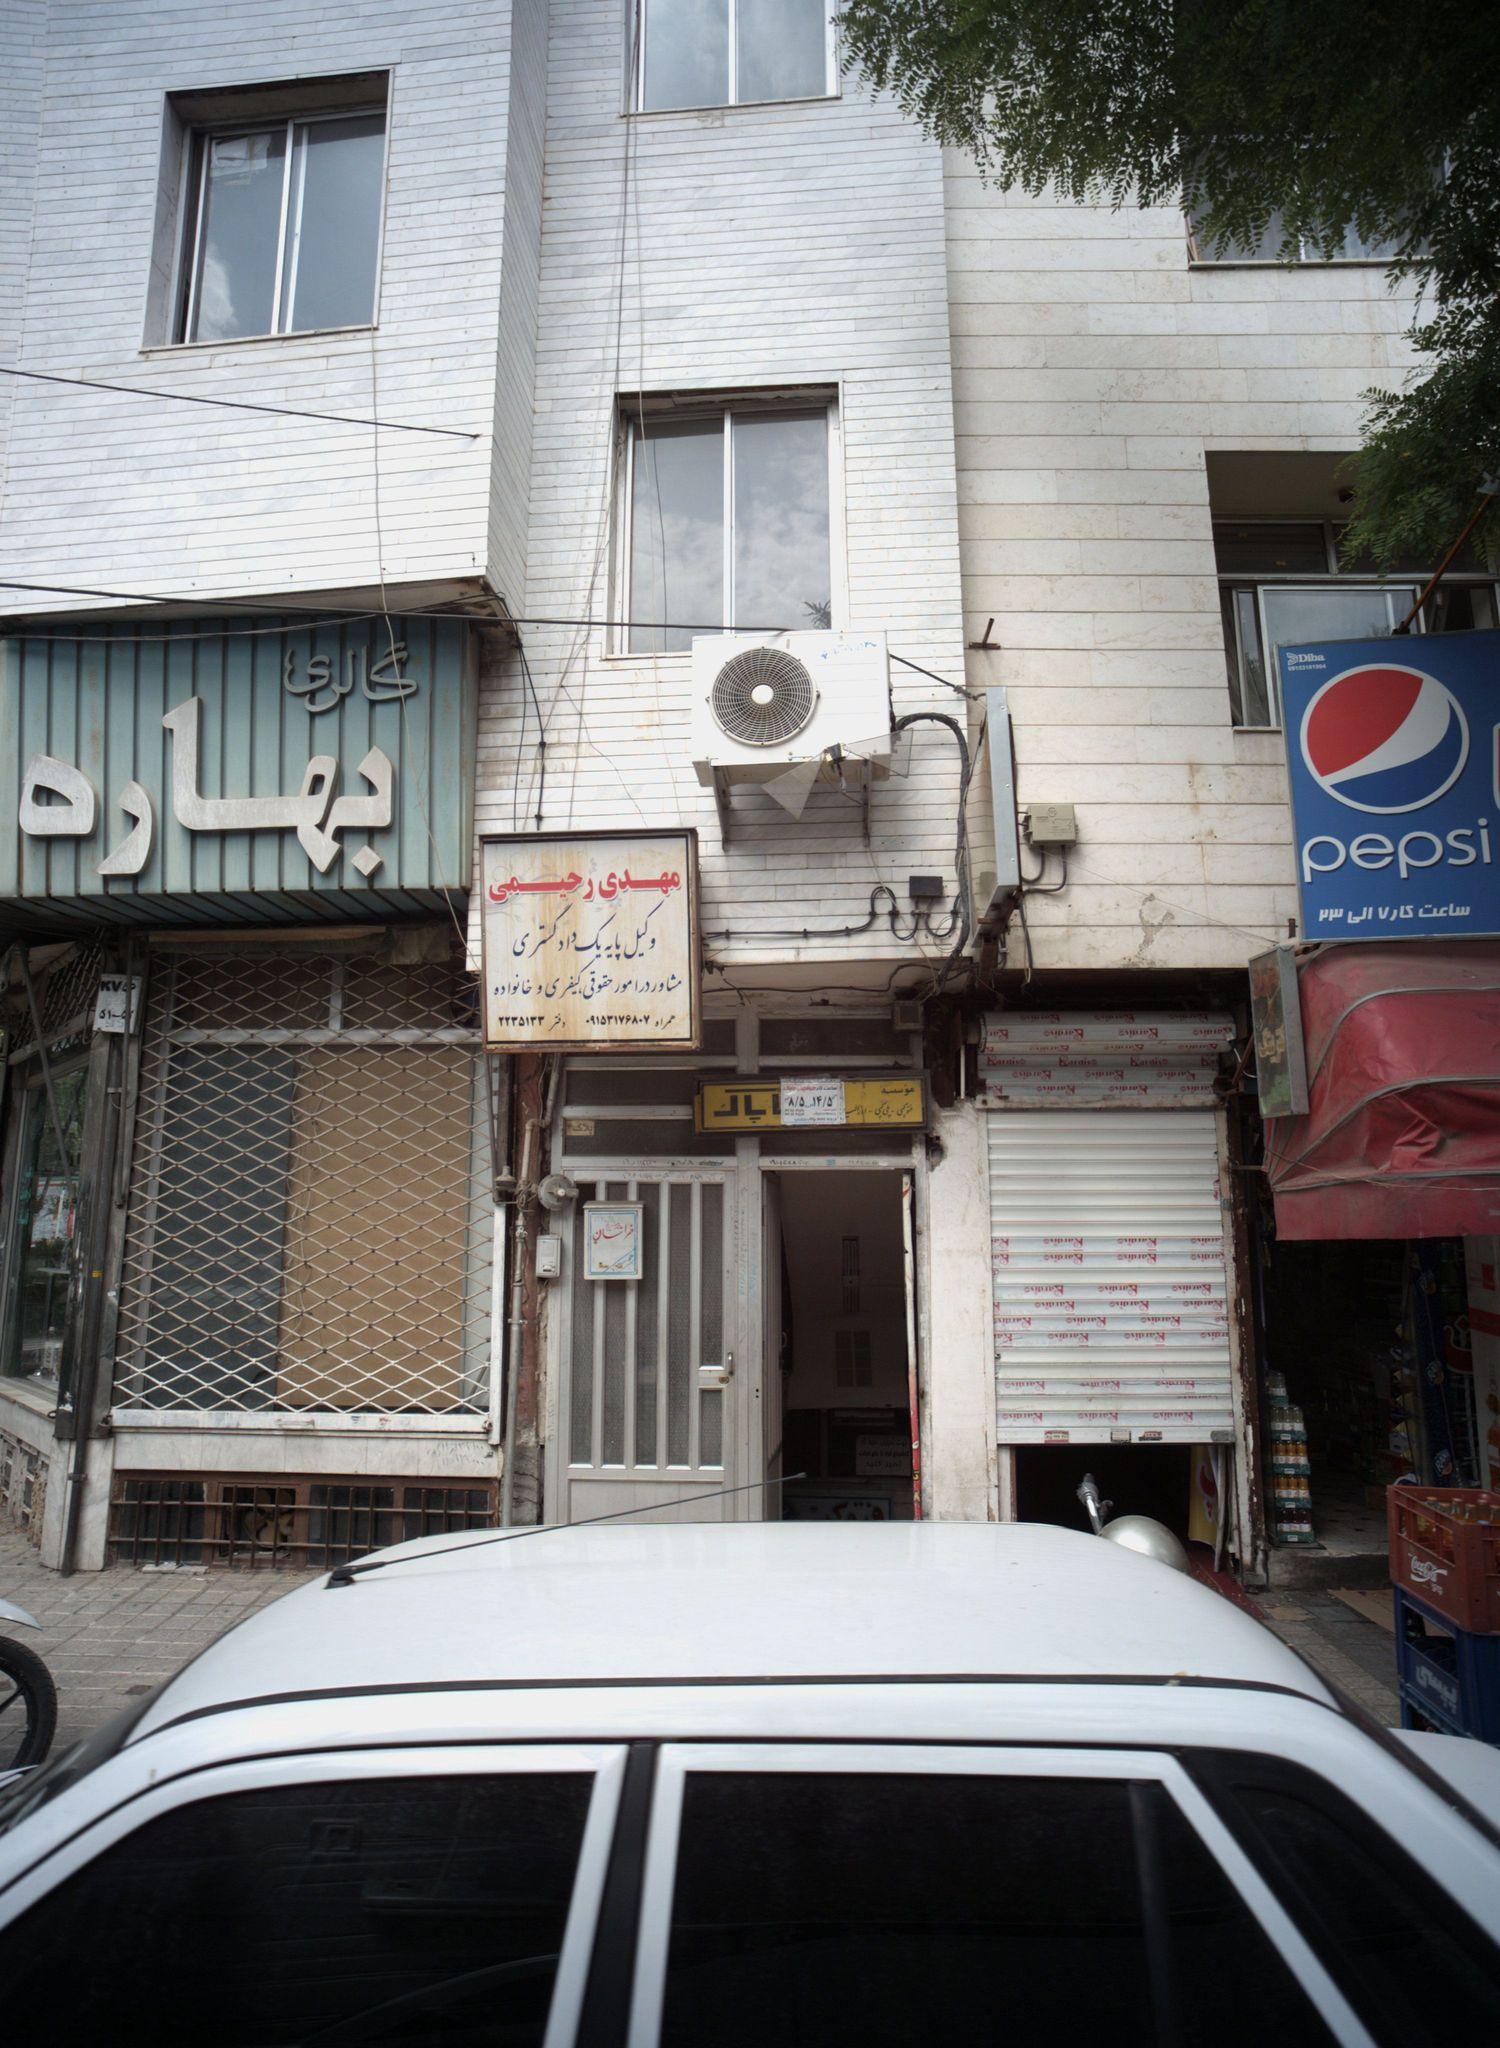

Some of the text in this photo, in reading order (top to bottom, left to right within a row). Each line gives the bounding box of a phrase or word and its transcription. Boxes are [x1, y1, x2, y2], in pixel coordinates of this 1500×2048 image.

[284, 642, 418, 713] گالری
[19, 696, 393, 878] بهاره
[1302, 818, 1492, 883] pepsi
[488, 868, 681, 902] مهدی رحیمی
[1318, 908, 1344, 922] ۲۳
[1347, 905, 1372, 924] الی
[1390, 904, 1414, 921] کار
[1418, 903, 1471, 918] ساعت
[512, 901, 664, 961] وکیل پایه یک دادگستری
[493, 975, 532, 996] خانواده
[545, 957, 596, 999] کیفری
[614, 979, 638, 994] امور
[640, 980, 650, 993] در
[651, 975, 682, 993] مشاور
